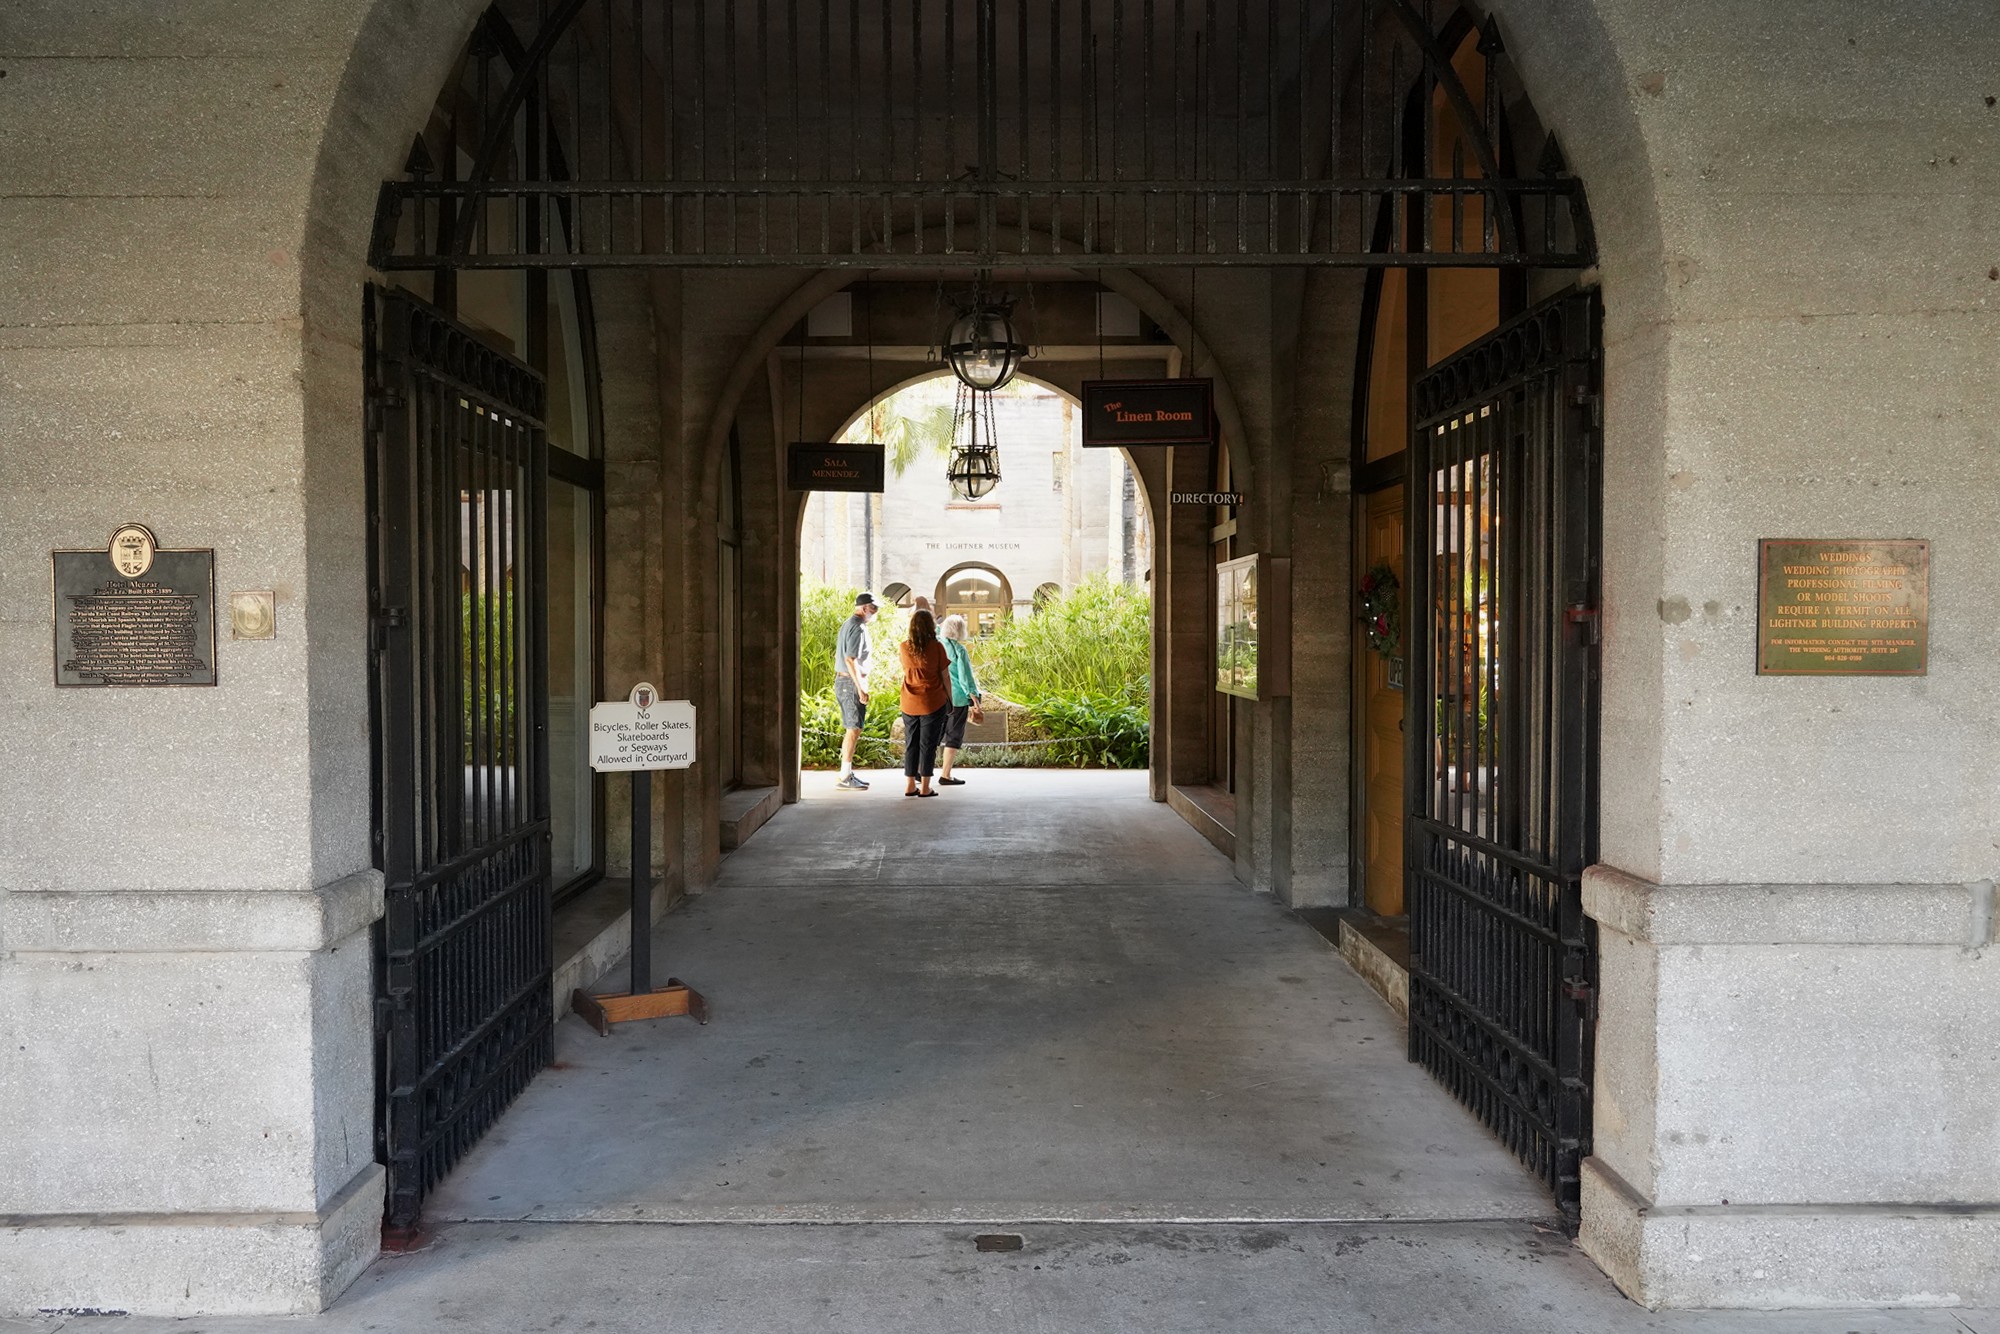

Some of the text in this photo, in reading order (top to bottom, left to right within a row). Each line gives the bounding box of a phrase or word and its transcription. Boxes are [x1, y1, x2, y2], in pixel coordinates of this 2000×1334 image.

[1103, 401, 1121, 413] The
[1116, 410, 1192, 422] Linen Room
[812, 470, 859, 478] MENENDEZ
[1172, 493, 1239, 504] DIRECTORY
[1819, 553, 1872, 562] WEDDINGS
[1783, 566, 1907, 575] WEDDING PHOTOGRAPHY
[1787, 579, 1902, 588] PROFESSIONAL FILMING
[1797, 592, 1892, 601] OR MODEL SHOOTS
[1777, 606, 1911, 615] REQUIRE A PERMIT ON ALL
[1769, 619, 1919, 628] LIGHTNER BUILDING PROPERTY
[637, 711, 650, 720] No
[635, 722, 659, 731] Roller
[617, 732, 669, 742] Skateboards
[618, 743, 668, 754] or Segways
[597, 752, 688, 764] Allowed in Courtyard
